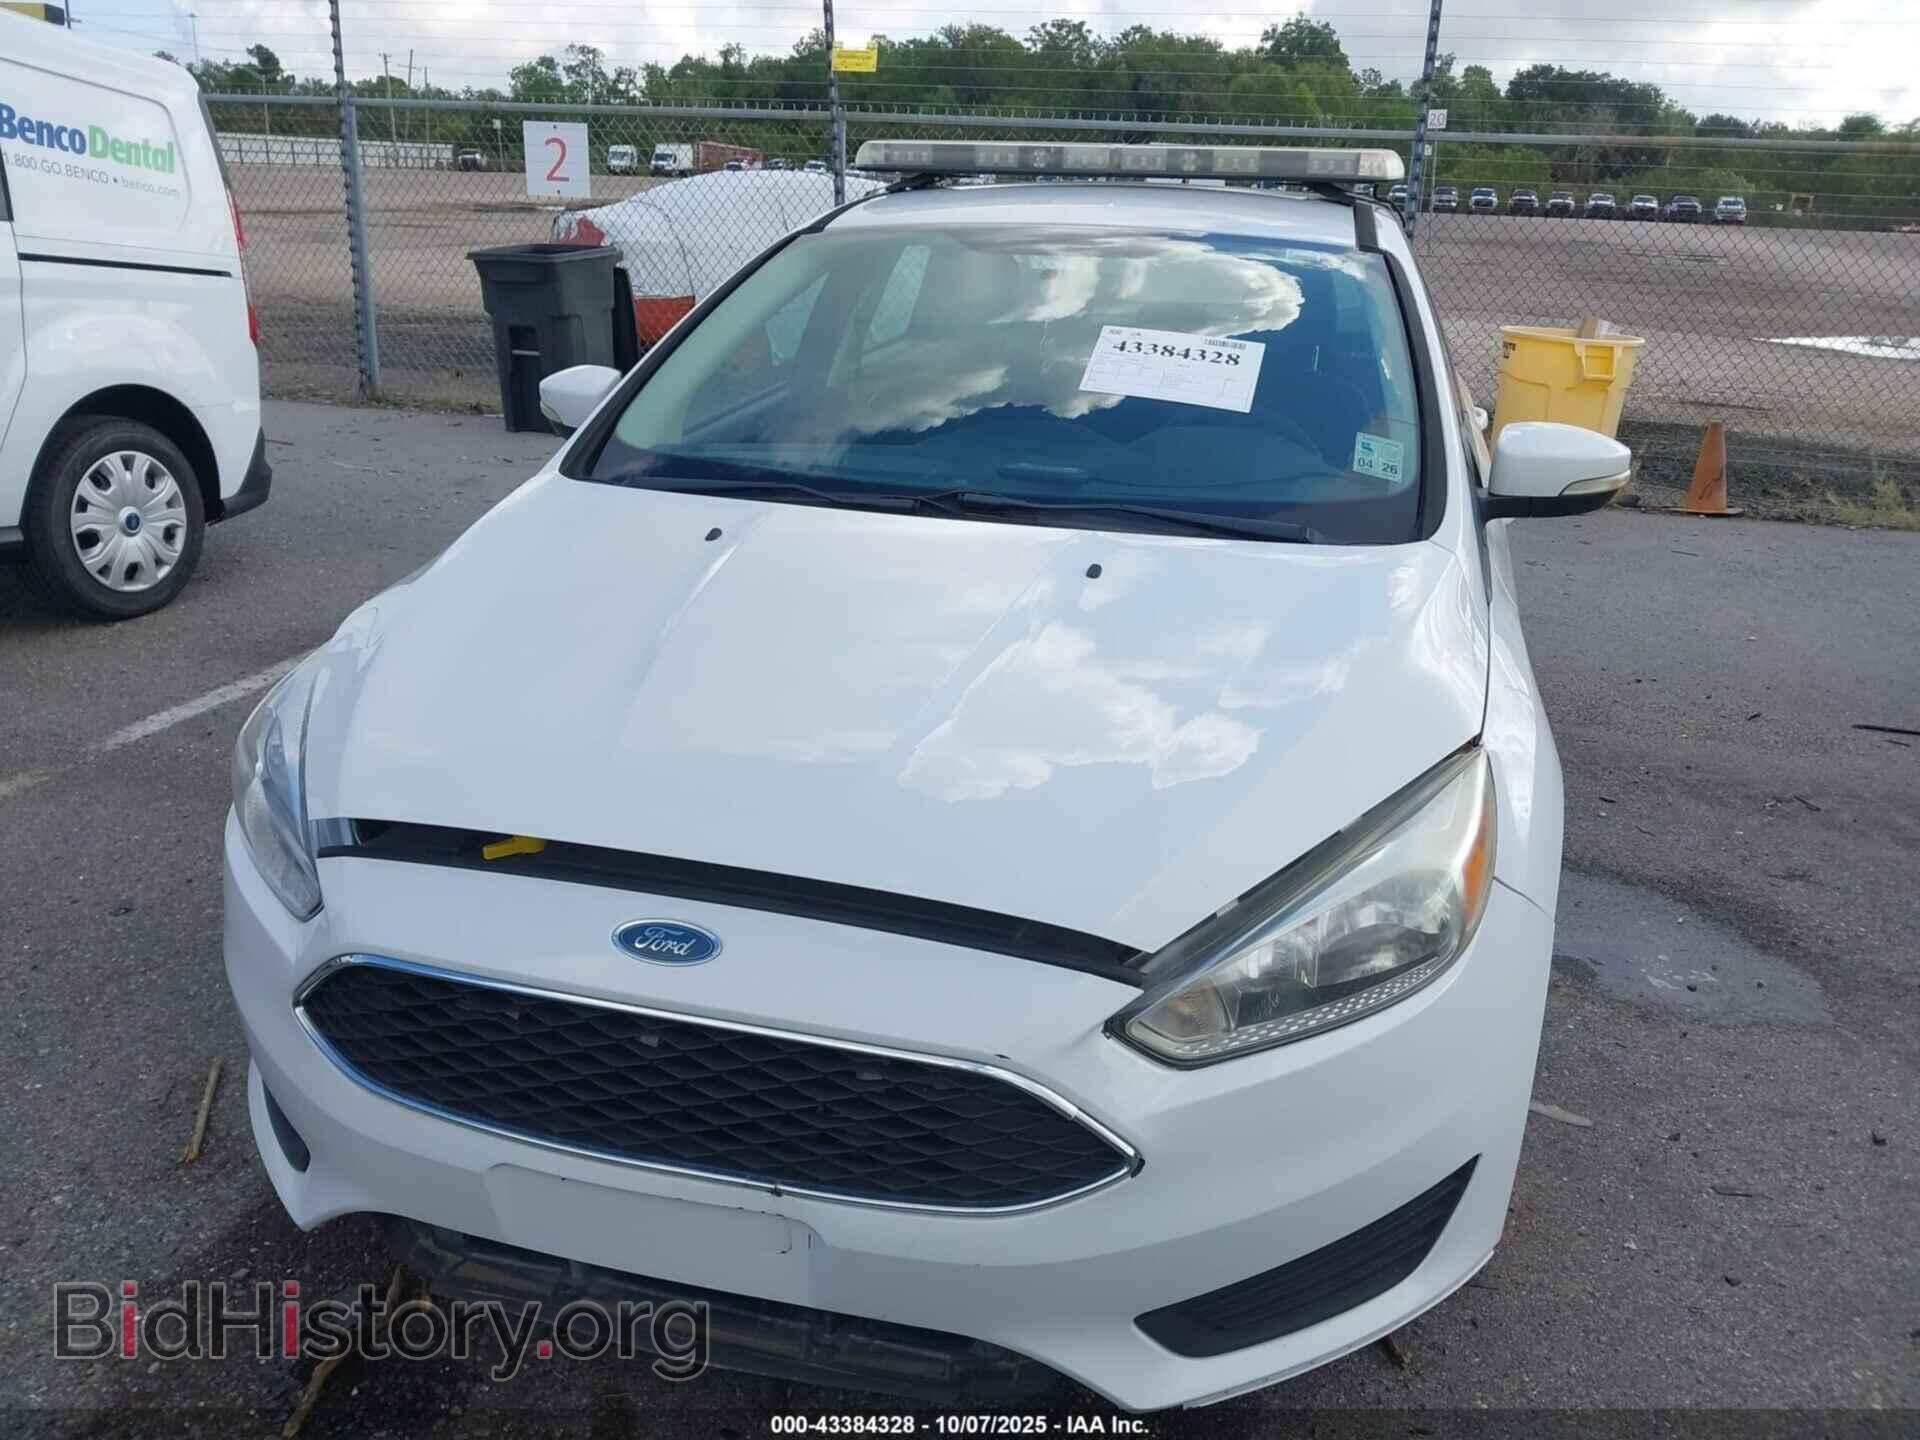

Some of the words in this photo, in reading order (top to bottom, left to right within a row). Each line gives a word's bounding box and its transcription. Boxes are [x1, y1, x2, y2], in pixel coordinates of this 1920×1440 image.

[545, 137, 571, 182] 2
[1112, 340, 1241, 366] 43384328
[1358, 457, 1373, 468] 04
[1382, 463, 1398, 474] 26
[634, 926, 697, 956] Ford
